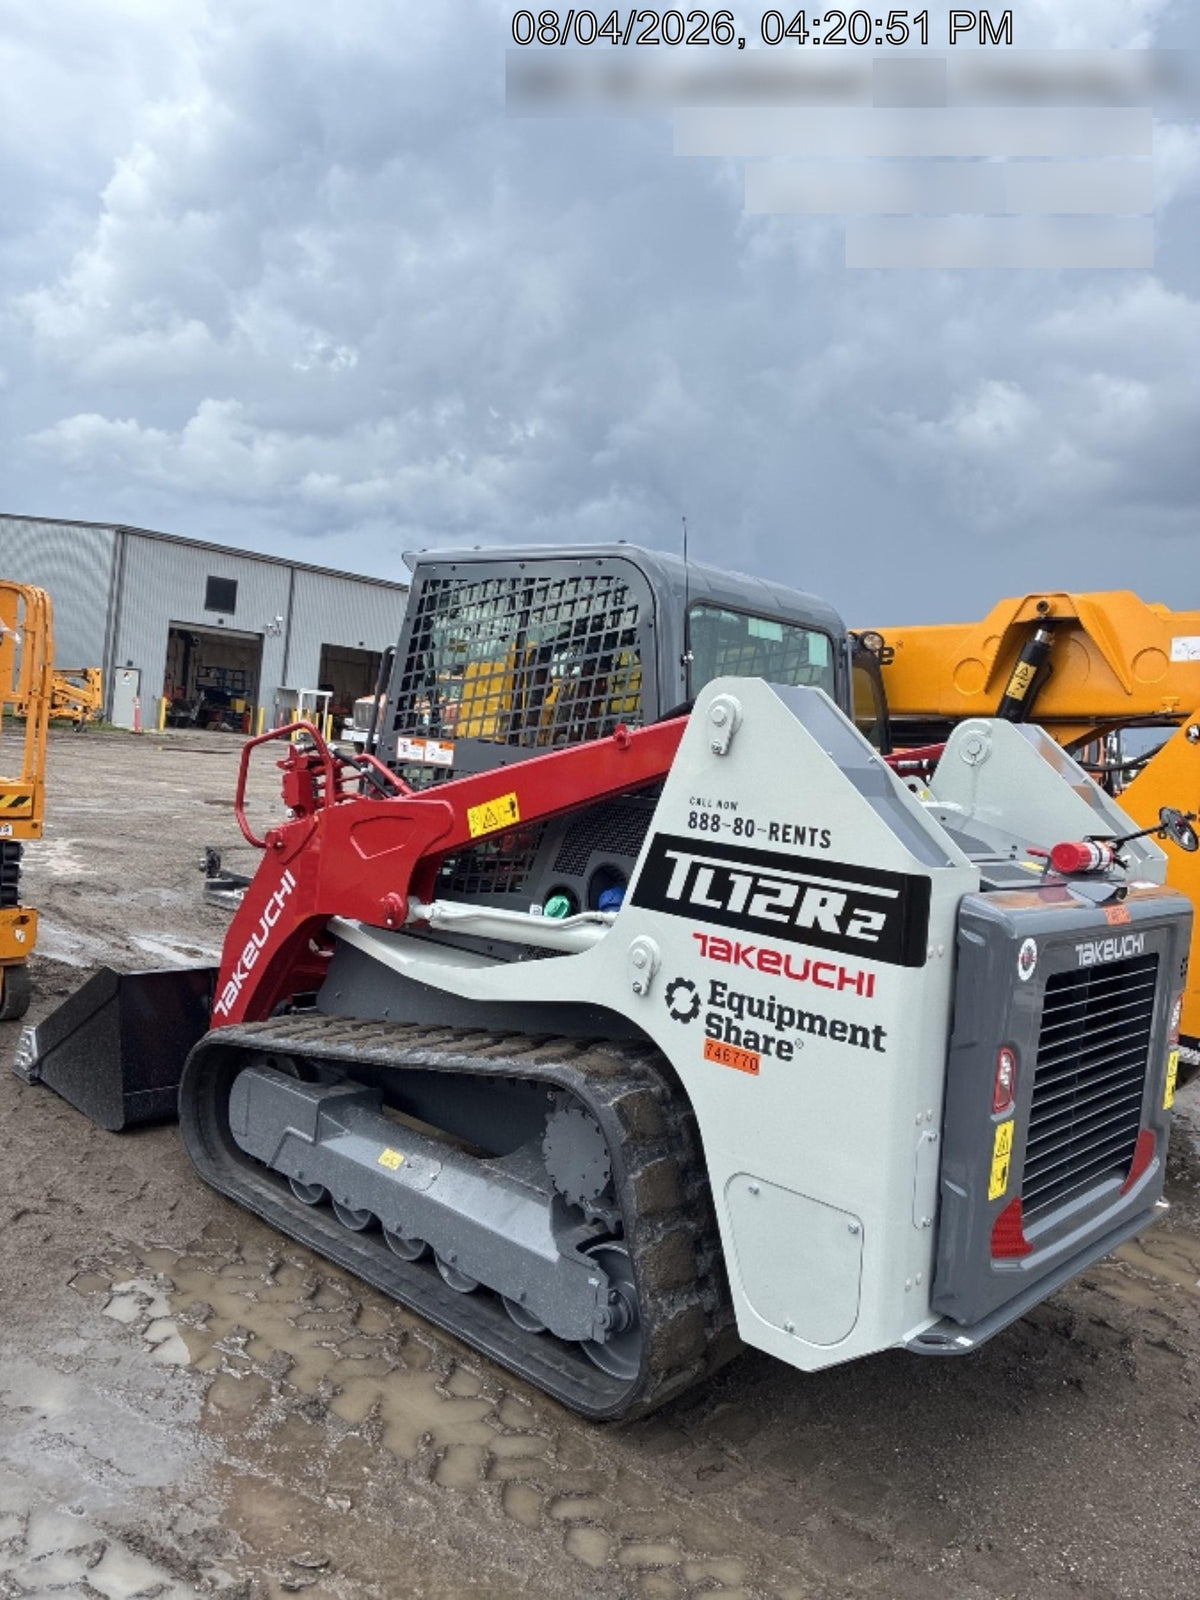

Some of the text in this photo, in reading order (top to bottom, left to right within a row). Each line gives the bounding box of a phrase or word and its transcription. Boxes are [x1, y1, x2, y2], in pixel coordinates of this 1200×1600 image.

[688, 811, 831, 849] 888-80-RENTS
[716, 800, 739, 811] NOW
[664, 850, 899, 942] TL12R2
[213, 869, 296, 1017] TAKEUCHI
[692, 932, 876, 998] TAKEUCHI
[707, 979, 887, 1052] Equipment
[705, 1043, 758, 1071] 746770
